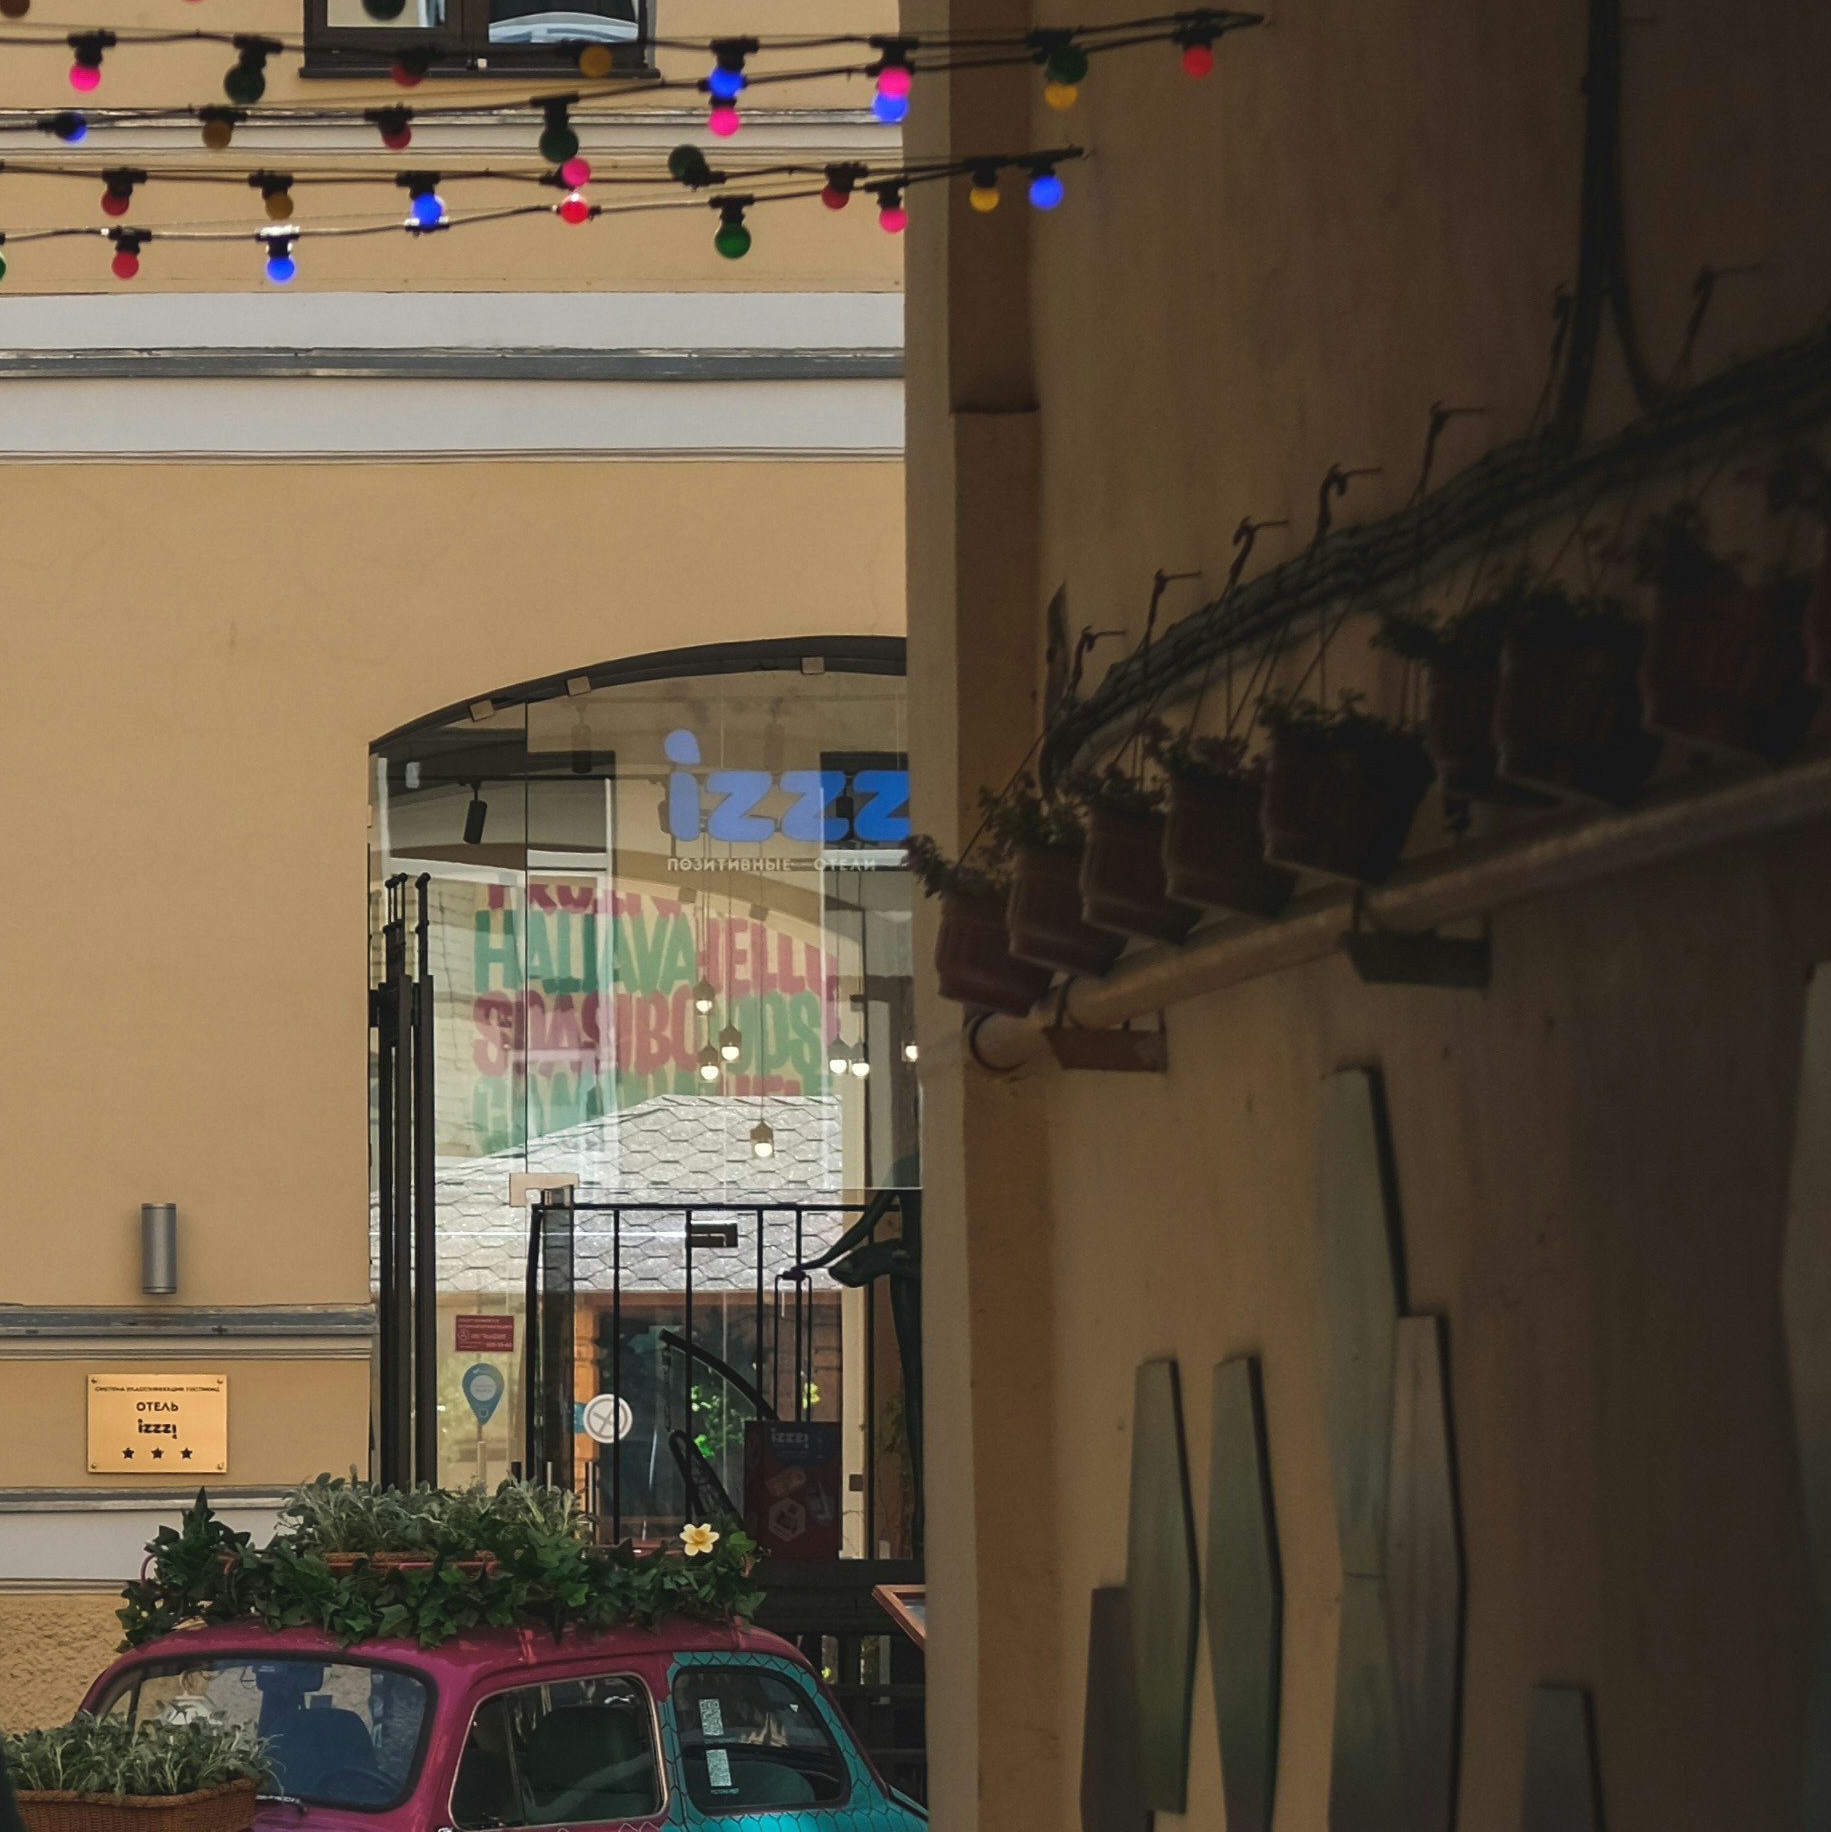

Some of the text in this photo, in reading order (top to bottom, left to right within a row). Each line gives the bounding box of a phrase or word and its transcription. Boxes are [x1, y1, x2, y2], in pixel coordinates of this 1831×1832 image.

[667, 858, 876, 872] ПОЗИТИВНЫЕ ОТЕЛИ
[136, 1402, 179, 1412] ОТЕЛЬ
